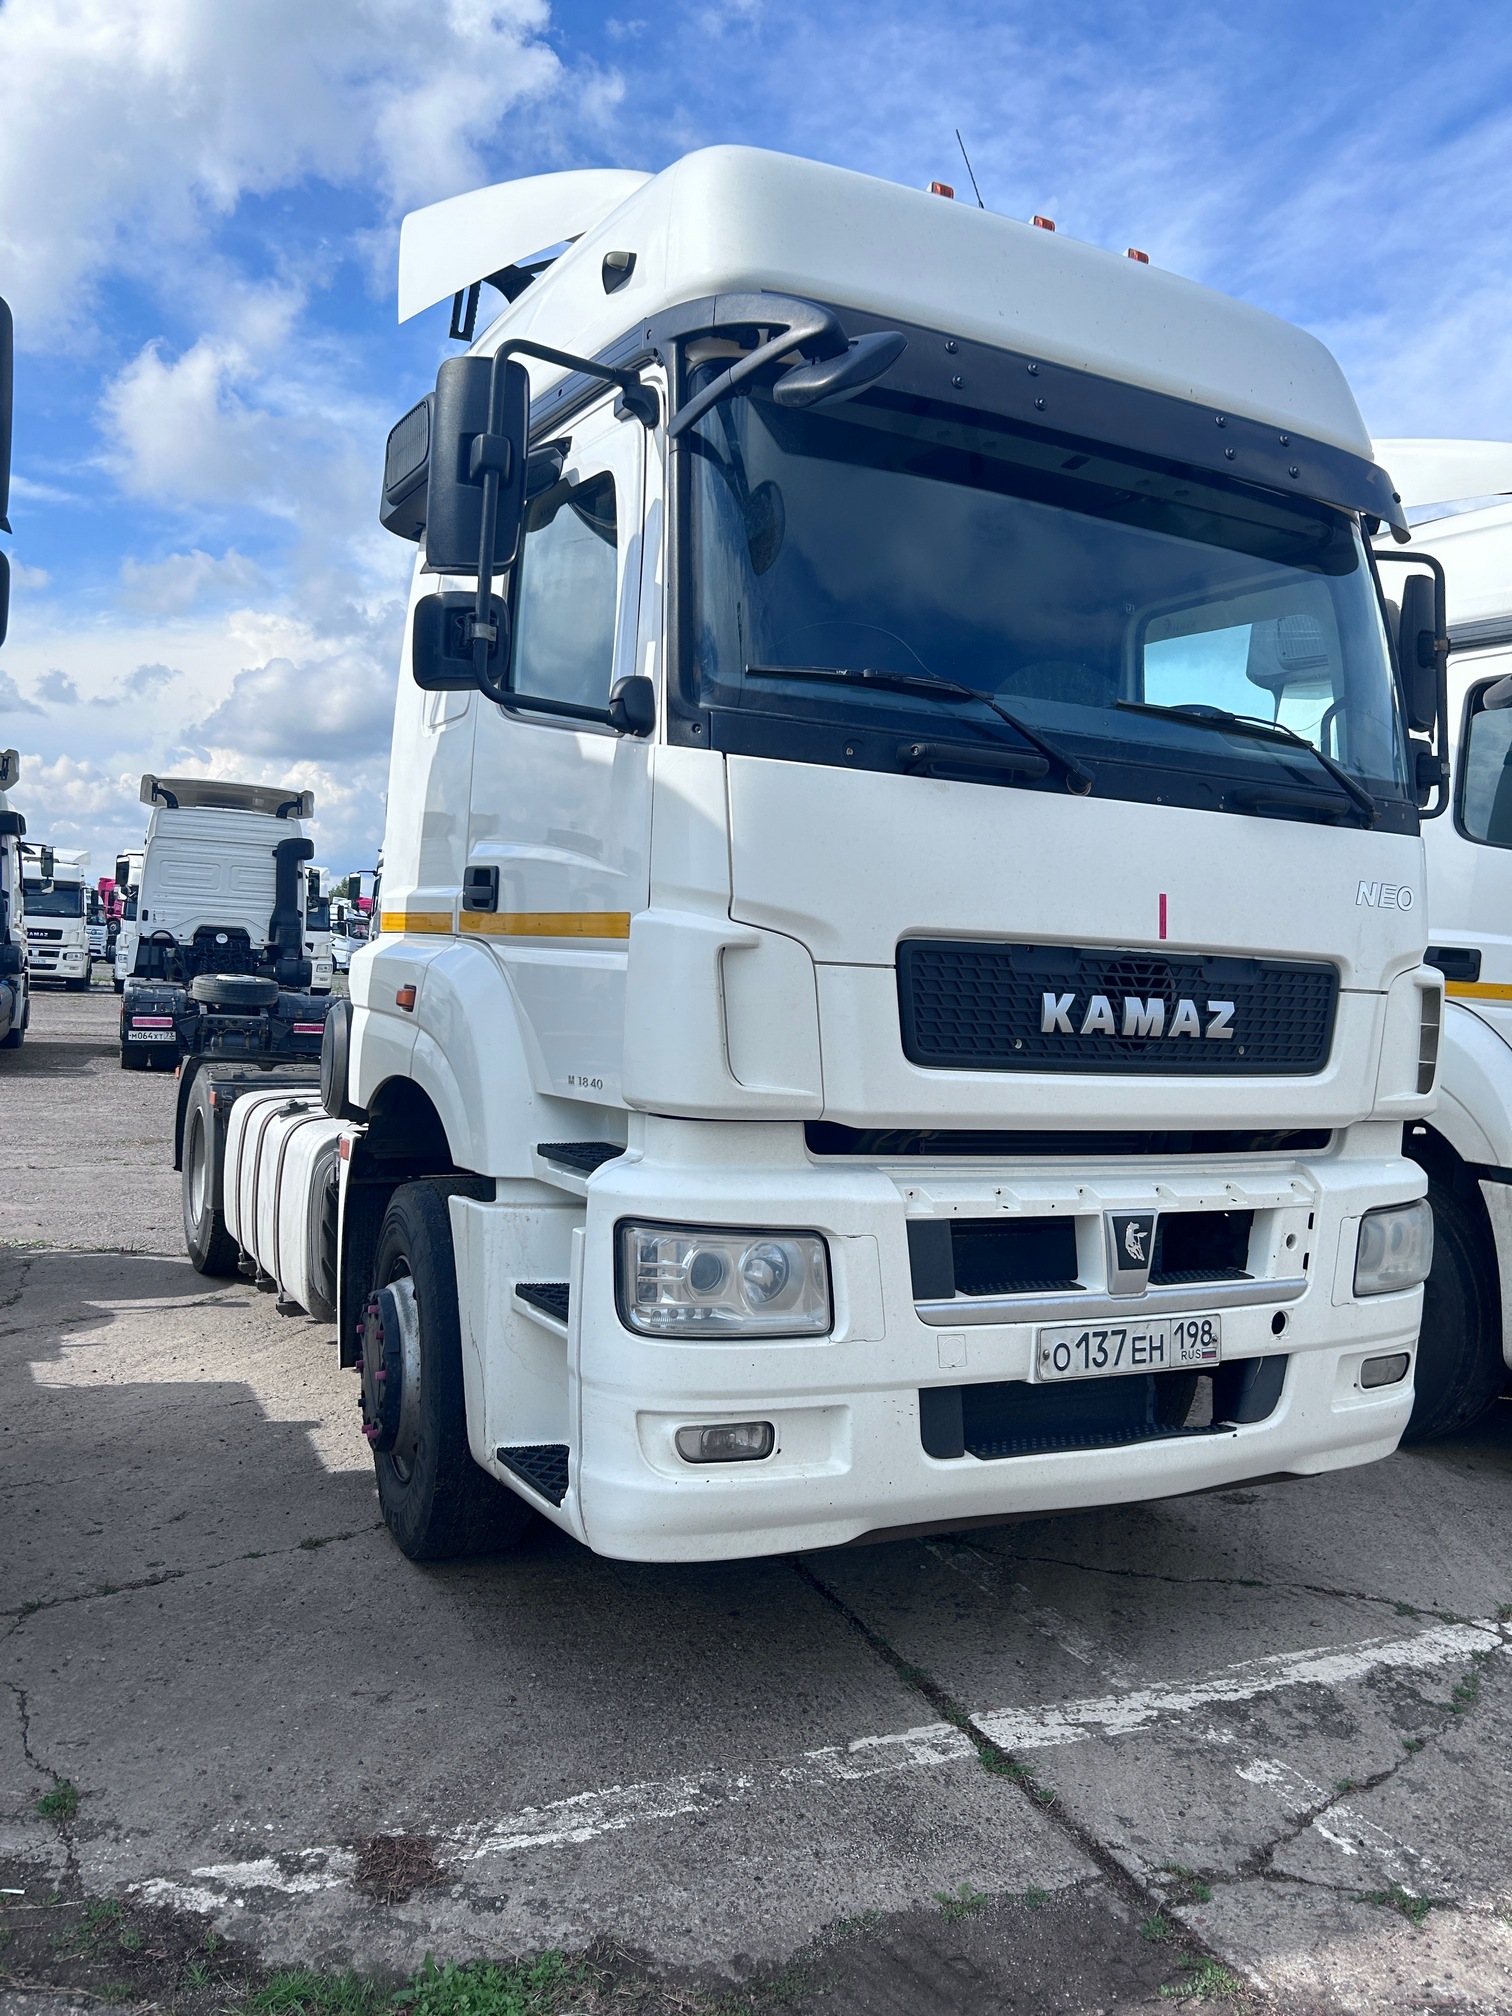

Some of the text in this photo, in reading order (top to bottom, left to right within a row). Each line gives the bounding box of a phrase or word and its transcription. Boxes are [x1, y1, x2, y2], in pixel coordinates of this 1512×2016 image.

[1356, 880, 1414, 911] NEO
[1041, 992, 1235, 1039] KAMAZ
[578, 1076, 603, 1090] 1840
[1173, 1319, 1213, 1349] 198
[1181, 1348, 1201, 1361] RUS
